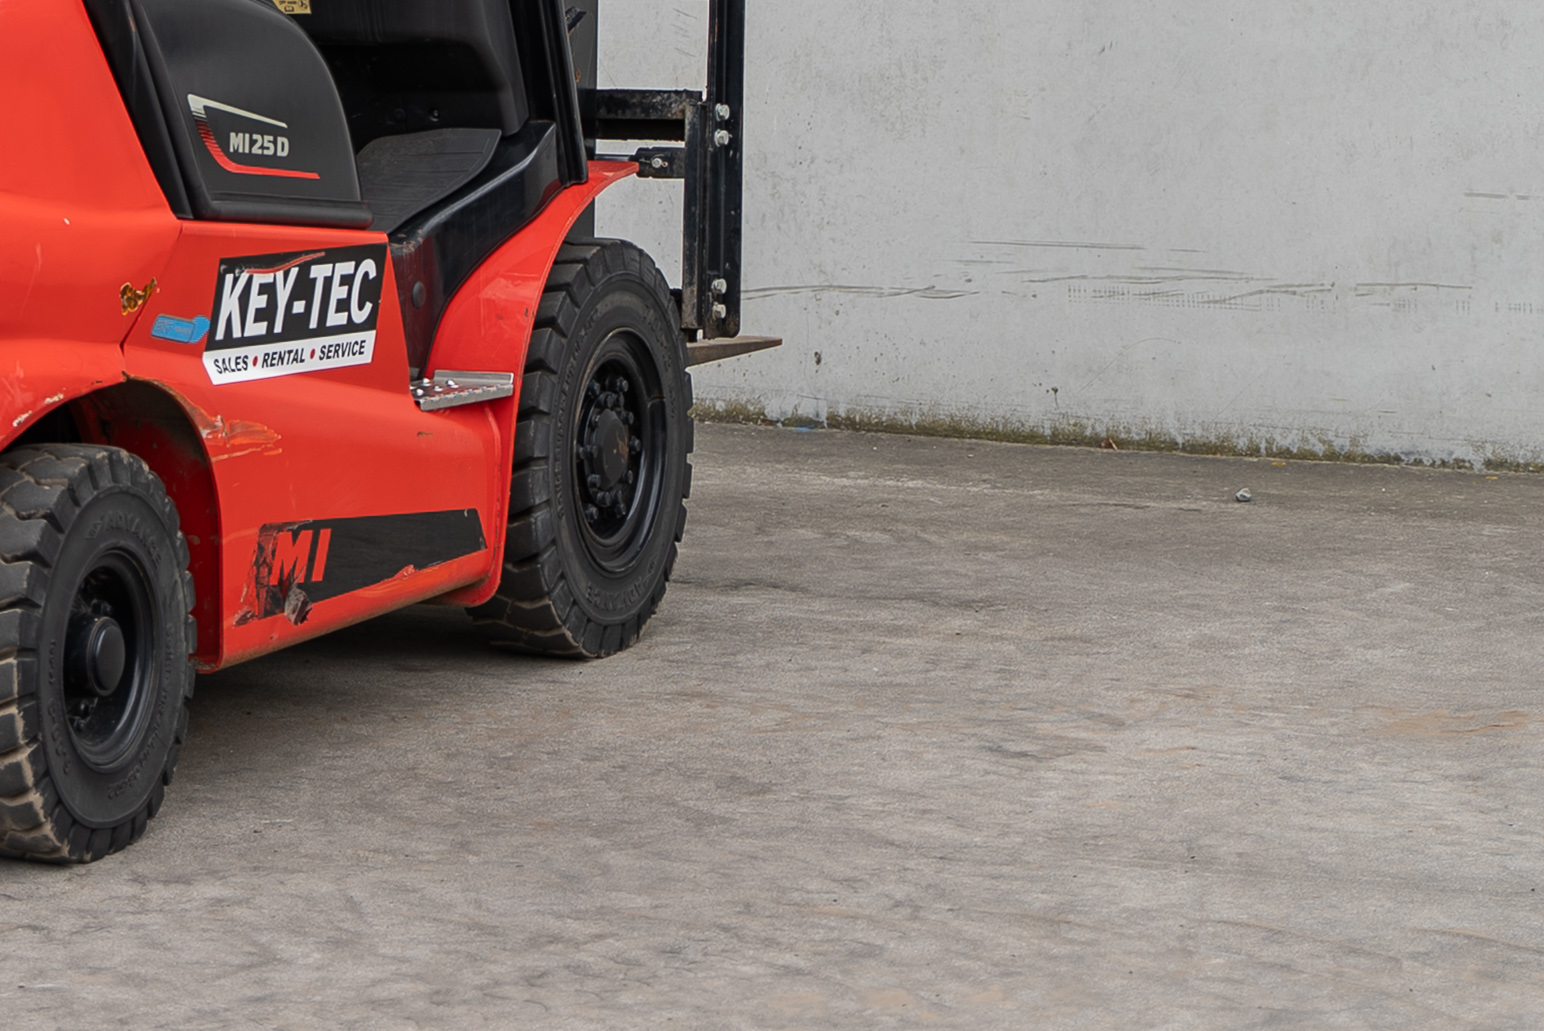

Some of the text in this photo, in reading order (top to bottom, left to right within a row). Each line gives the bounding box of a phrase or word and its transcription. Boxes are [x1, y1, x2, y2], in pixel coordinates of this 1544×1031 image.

[214, 258, 377, 341] KEY-TEC
[213, 339, 367, 375] SALES RENTAL SERVICE
[270, 528, 332, 586] MI
